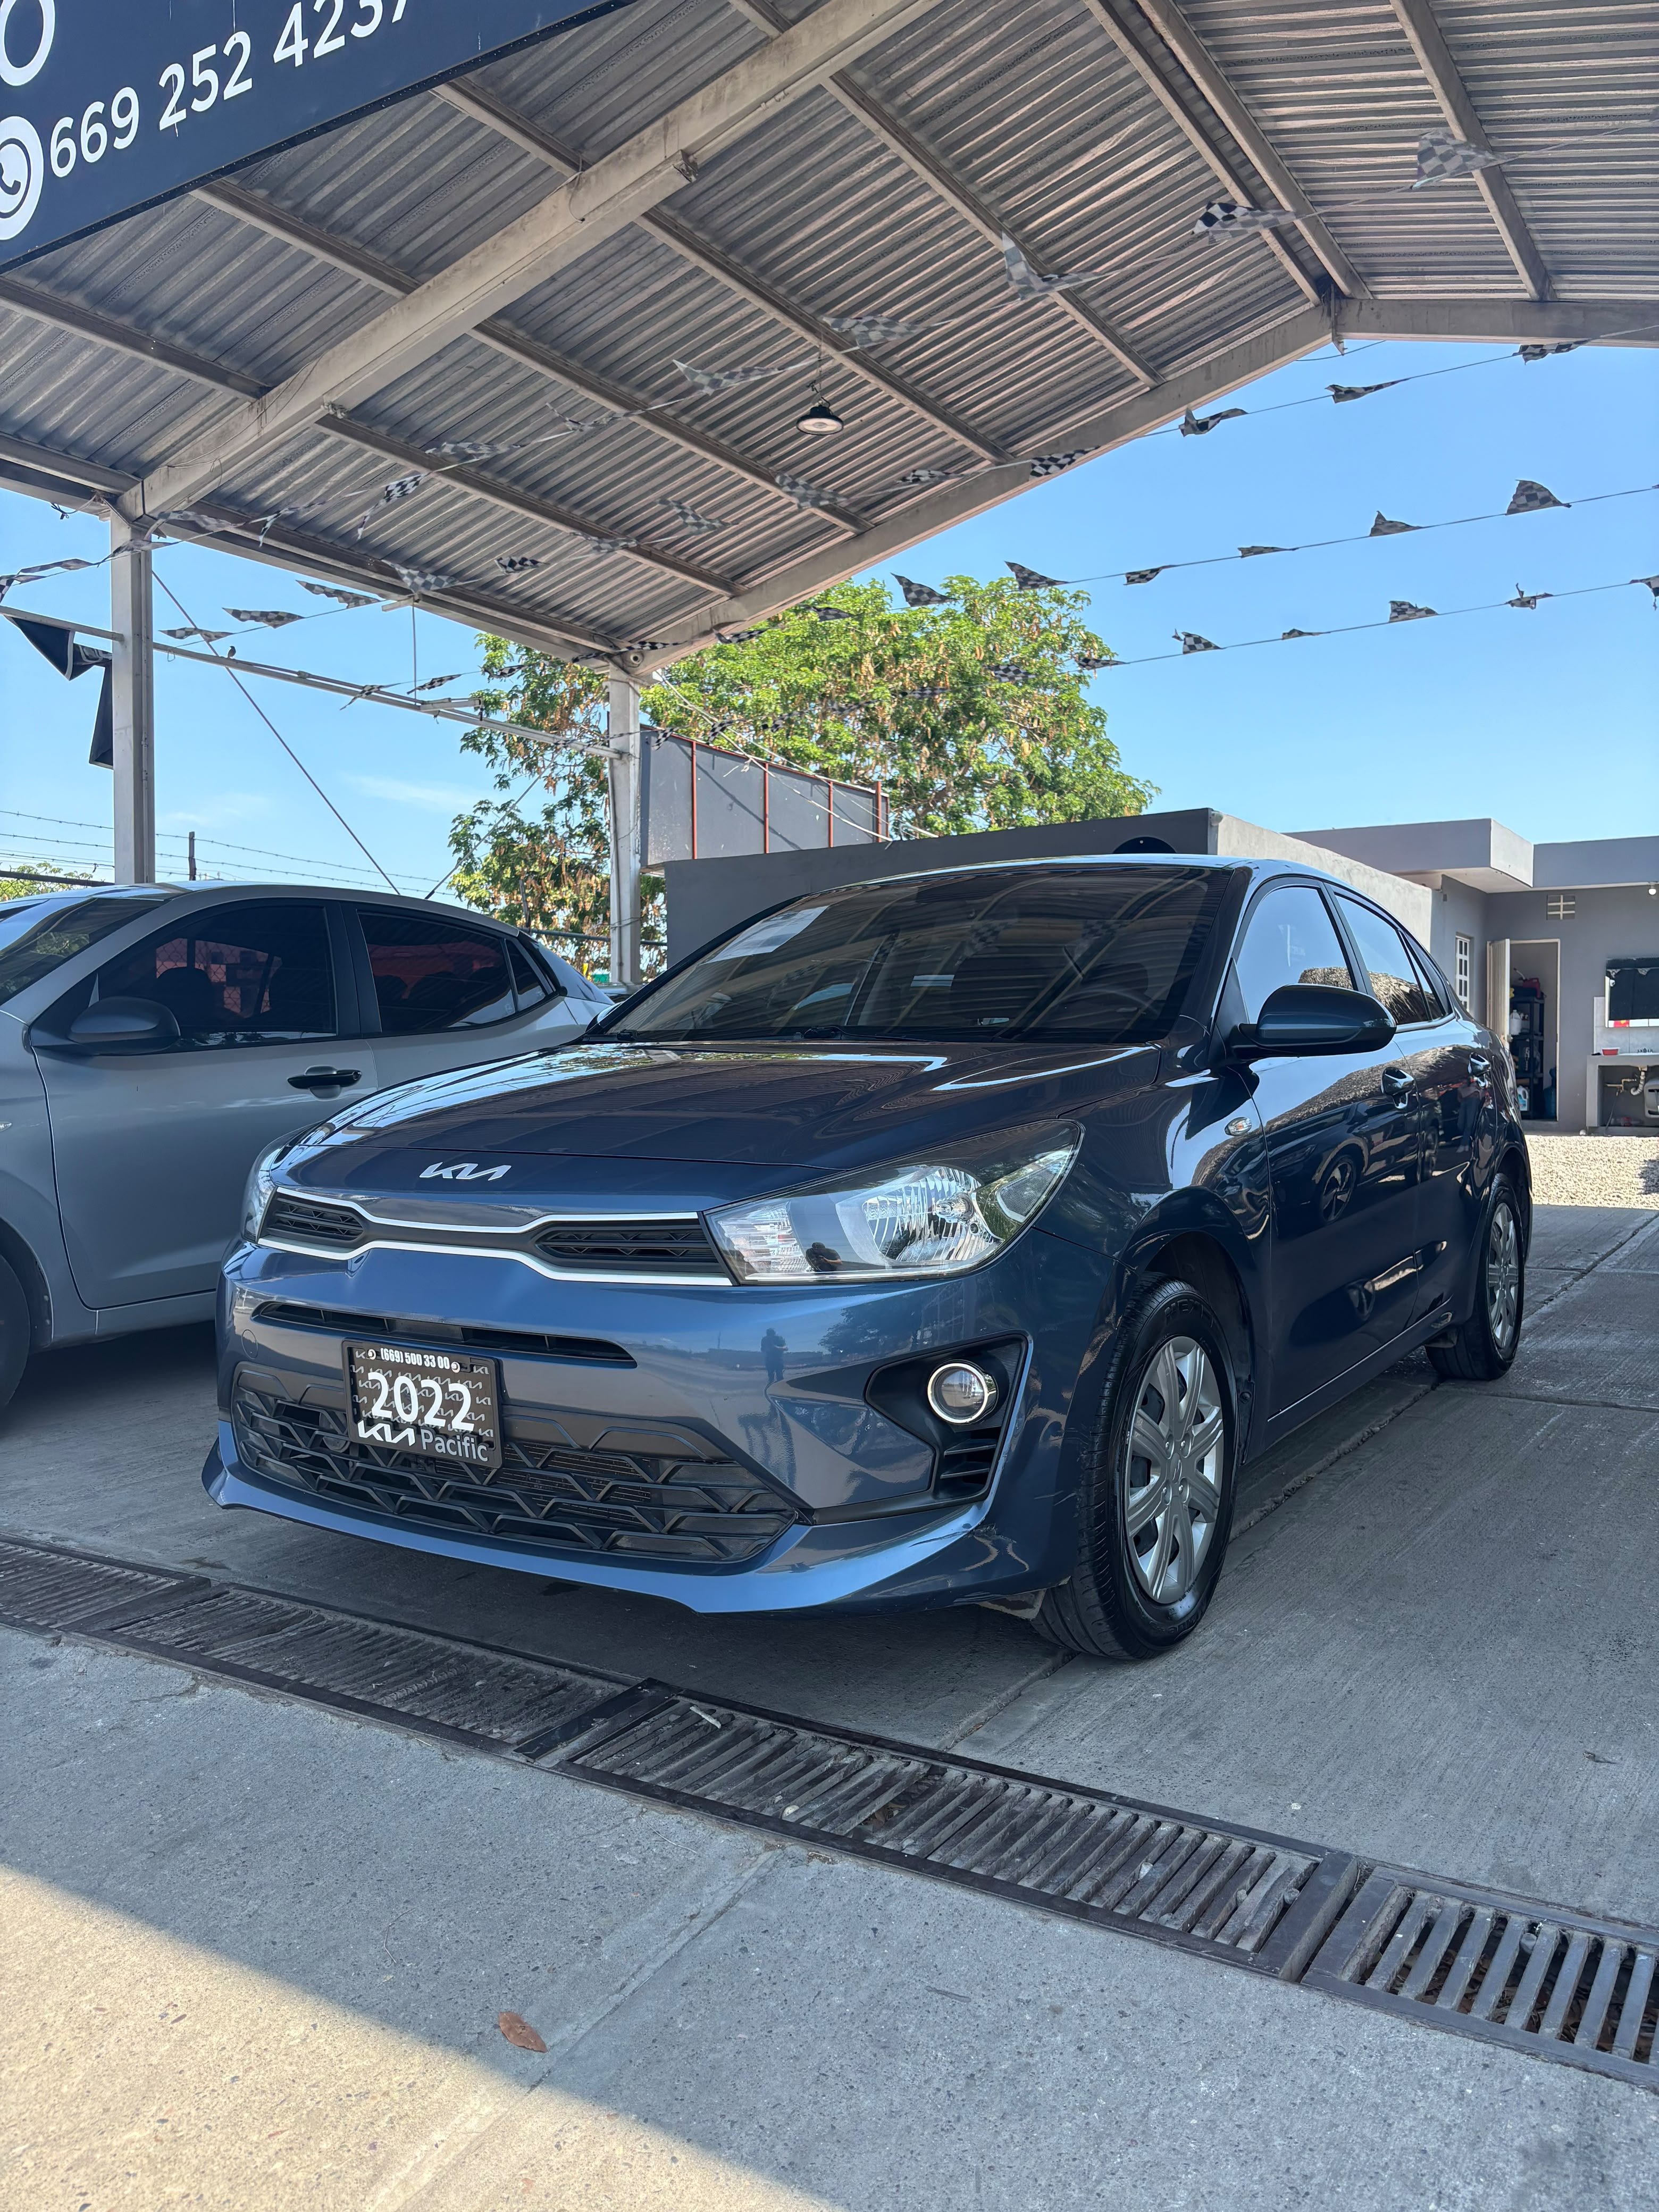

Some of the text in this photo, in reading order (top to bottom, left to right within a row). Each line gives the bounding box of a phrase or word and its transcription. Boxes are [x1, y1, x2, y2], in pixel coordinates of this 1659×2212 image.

[51, 87, 139, 178] 669
[159, 31, 253, 129] 252
[380, 1348, 404, 1363] (669)
[405, 1352, 423, 1366] 500
[423, 1354, 436, 1368] 33
[437, 1356, 450, 1370] 00
[368, 1372, 474, 1431] 2022
[421, 1429, 488, 1462] Pacific
